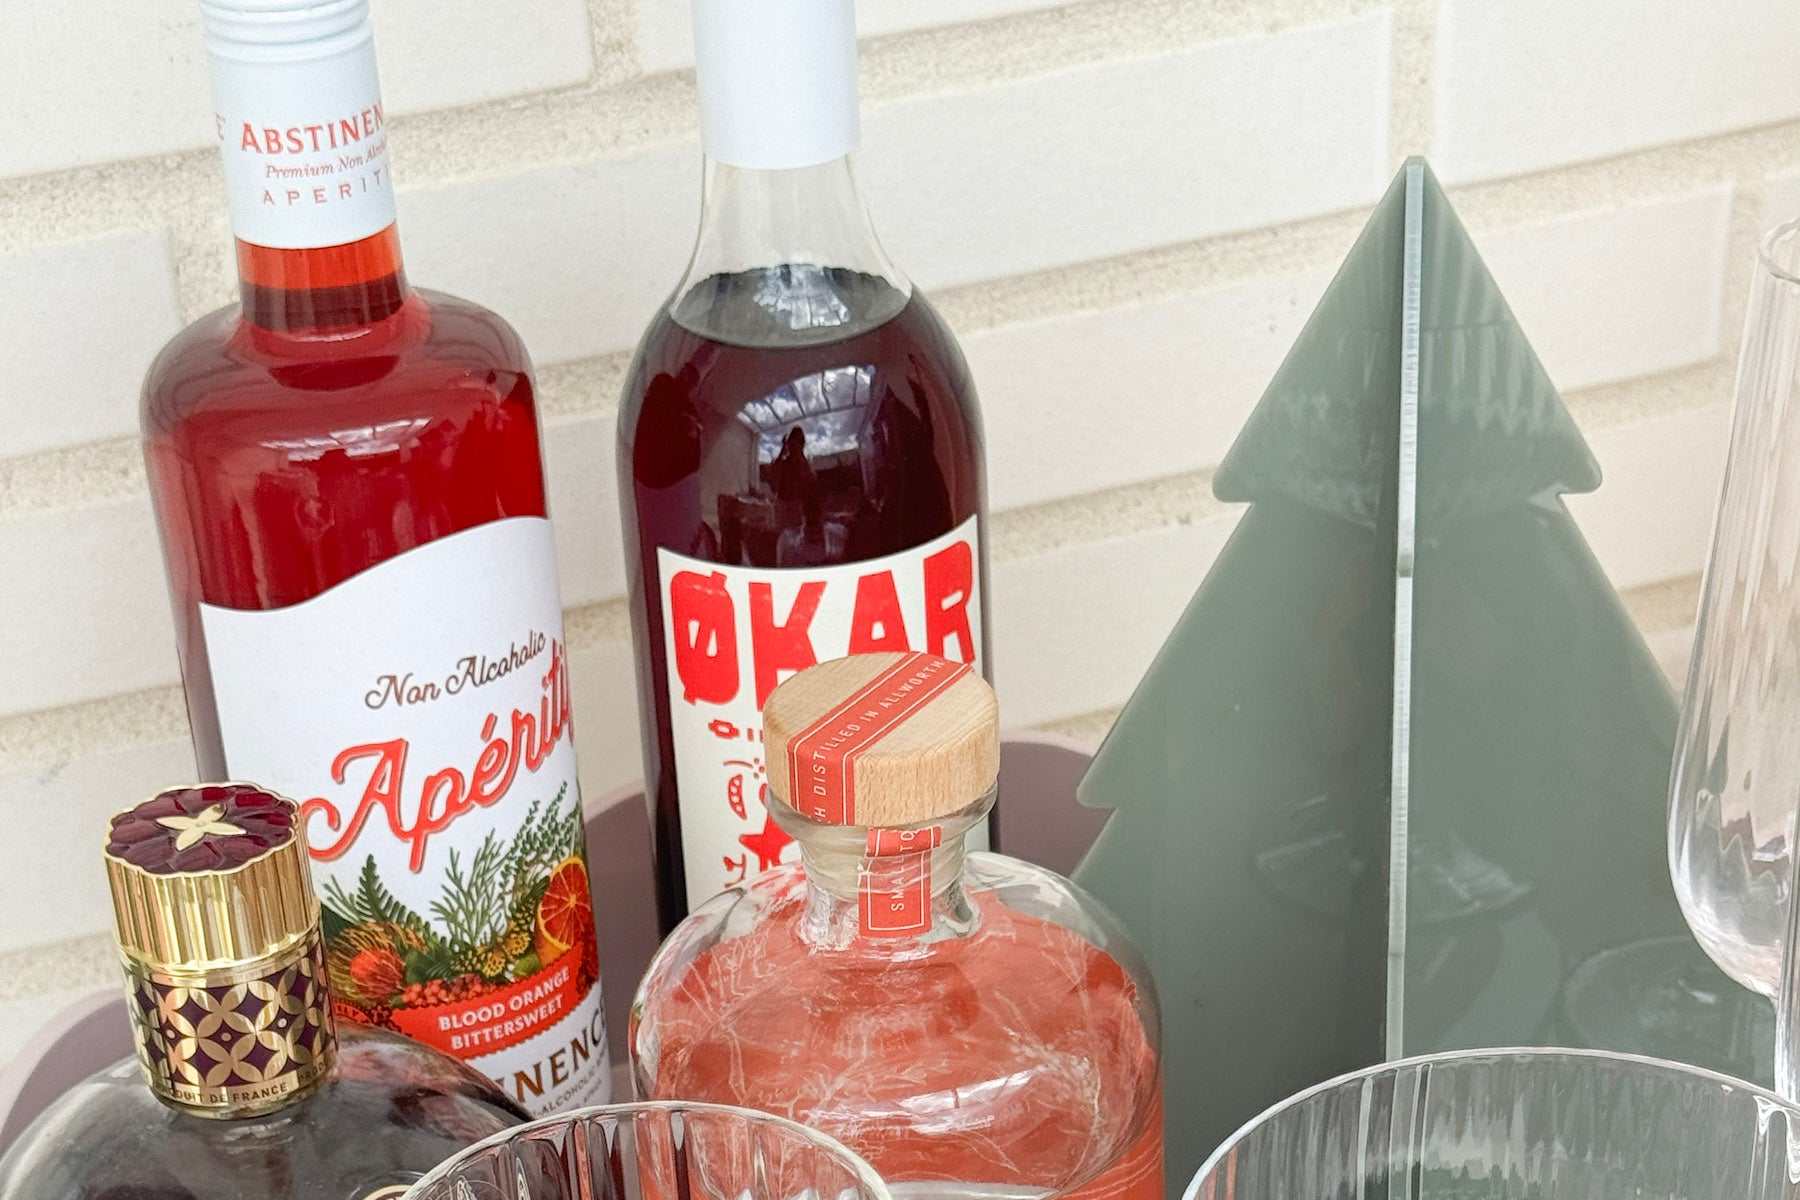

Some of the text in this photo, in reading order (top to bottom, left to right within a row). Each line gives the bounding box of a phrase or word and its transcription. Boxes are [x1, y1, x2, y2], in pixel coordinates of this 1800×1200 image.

[265, 161, 334, 179] Premium
[337, 155, 363, 172] Non
[365, 629, 547, 710] Non Alcoholic
[812, 723, 861, 796] DISTILLED
[859, 709, 880, 723] IN
[878, 659, 946, 709] ALLWORTH
[437, 965, 571, 1032] BLOOD ORANGE
[450, 992, 565, 1051] BITTERSWEET
[208, 1094, 228, 1105] DE
[231, 1081, 290, 1104] FRANCE
